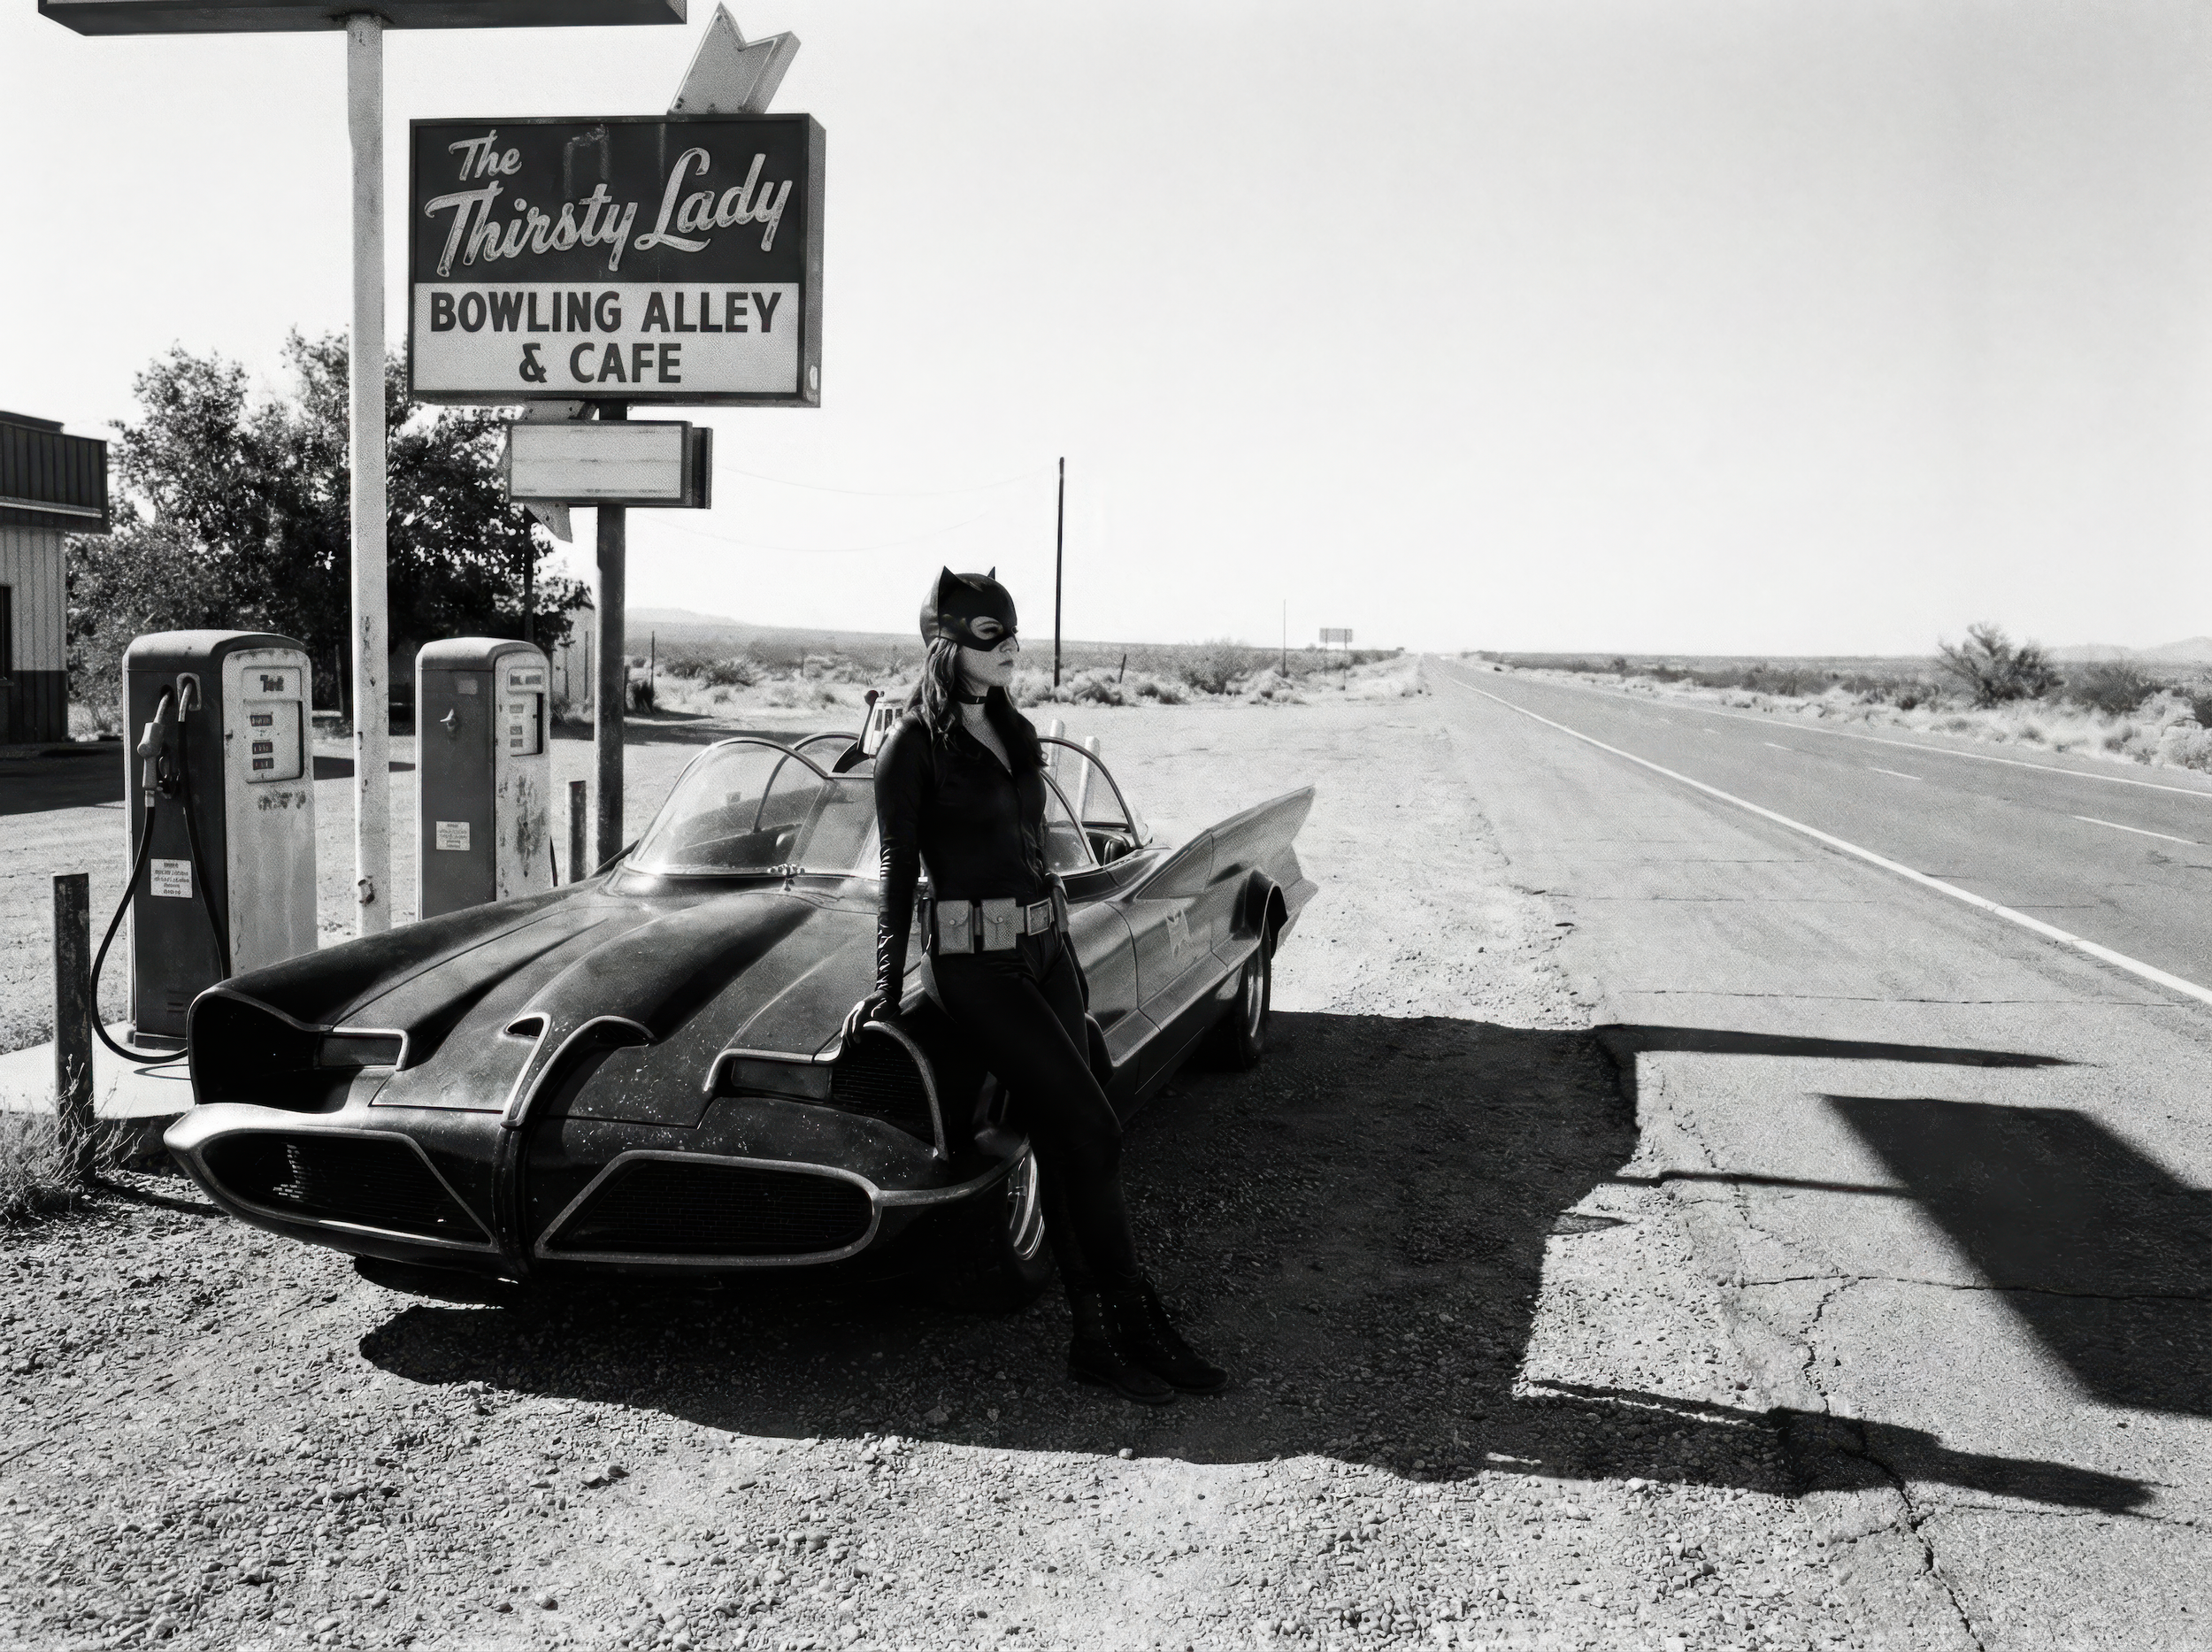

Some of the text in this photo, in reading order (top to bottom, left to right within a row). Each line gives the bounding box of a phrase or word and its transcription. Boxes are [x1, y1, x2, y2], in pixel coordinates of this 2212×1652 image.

[448, 129, 523, 181] The
[425, 147, 794, 278] Thirsty Lady
[430, 290, 782, 334] BOWLING ALLEY
[518, 342, 682, 383] & CAFE
